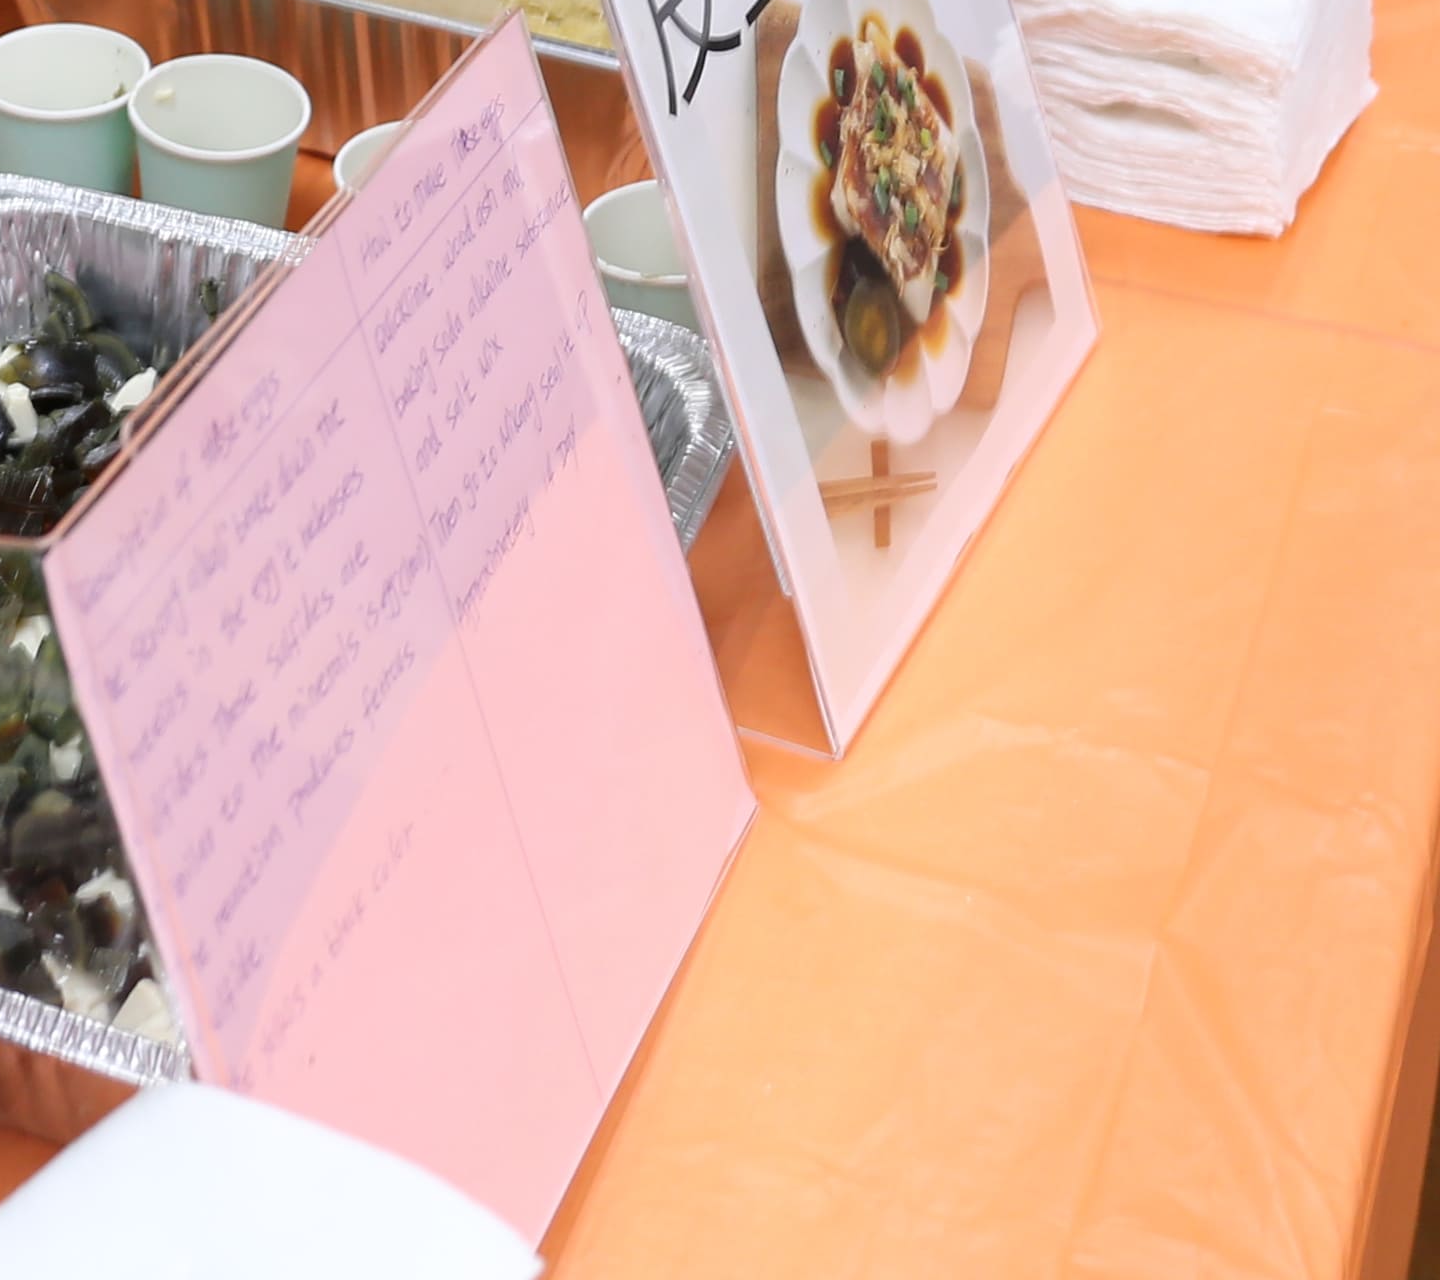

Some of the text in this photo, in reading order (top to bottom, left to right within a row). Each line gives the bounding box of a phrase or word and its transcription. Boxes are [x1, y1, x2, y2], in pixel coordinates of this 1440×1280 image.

[394, 197, 413, 234] to
[468, 252, 513, 320] alkaline
[241, 368, 282, 432] eggs
[415, 414, 443, 475] and
[445, 369, 477, 432] salt
[461, 470, 481, 513] go
[478, 445, 499, 483] to
[539, 343, 564, 402] seal
